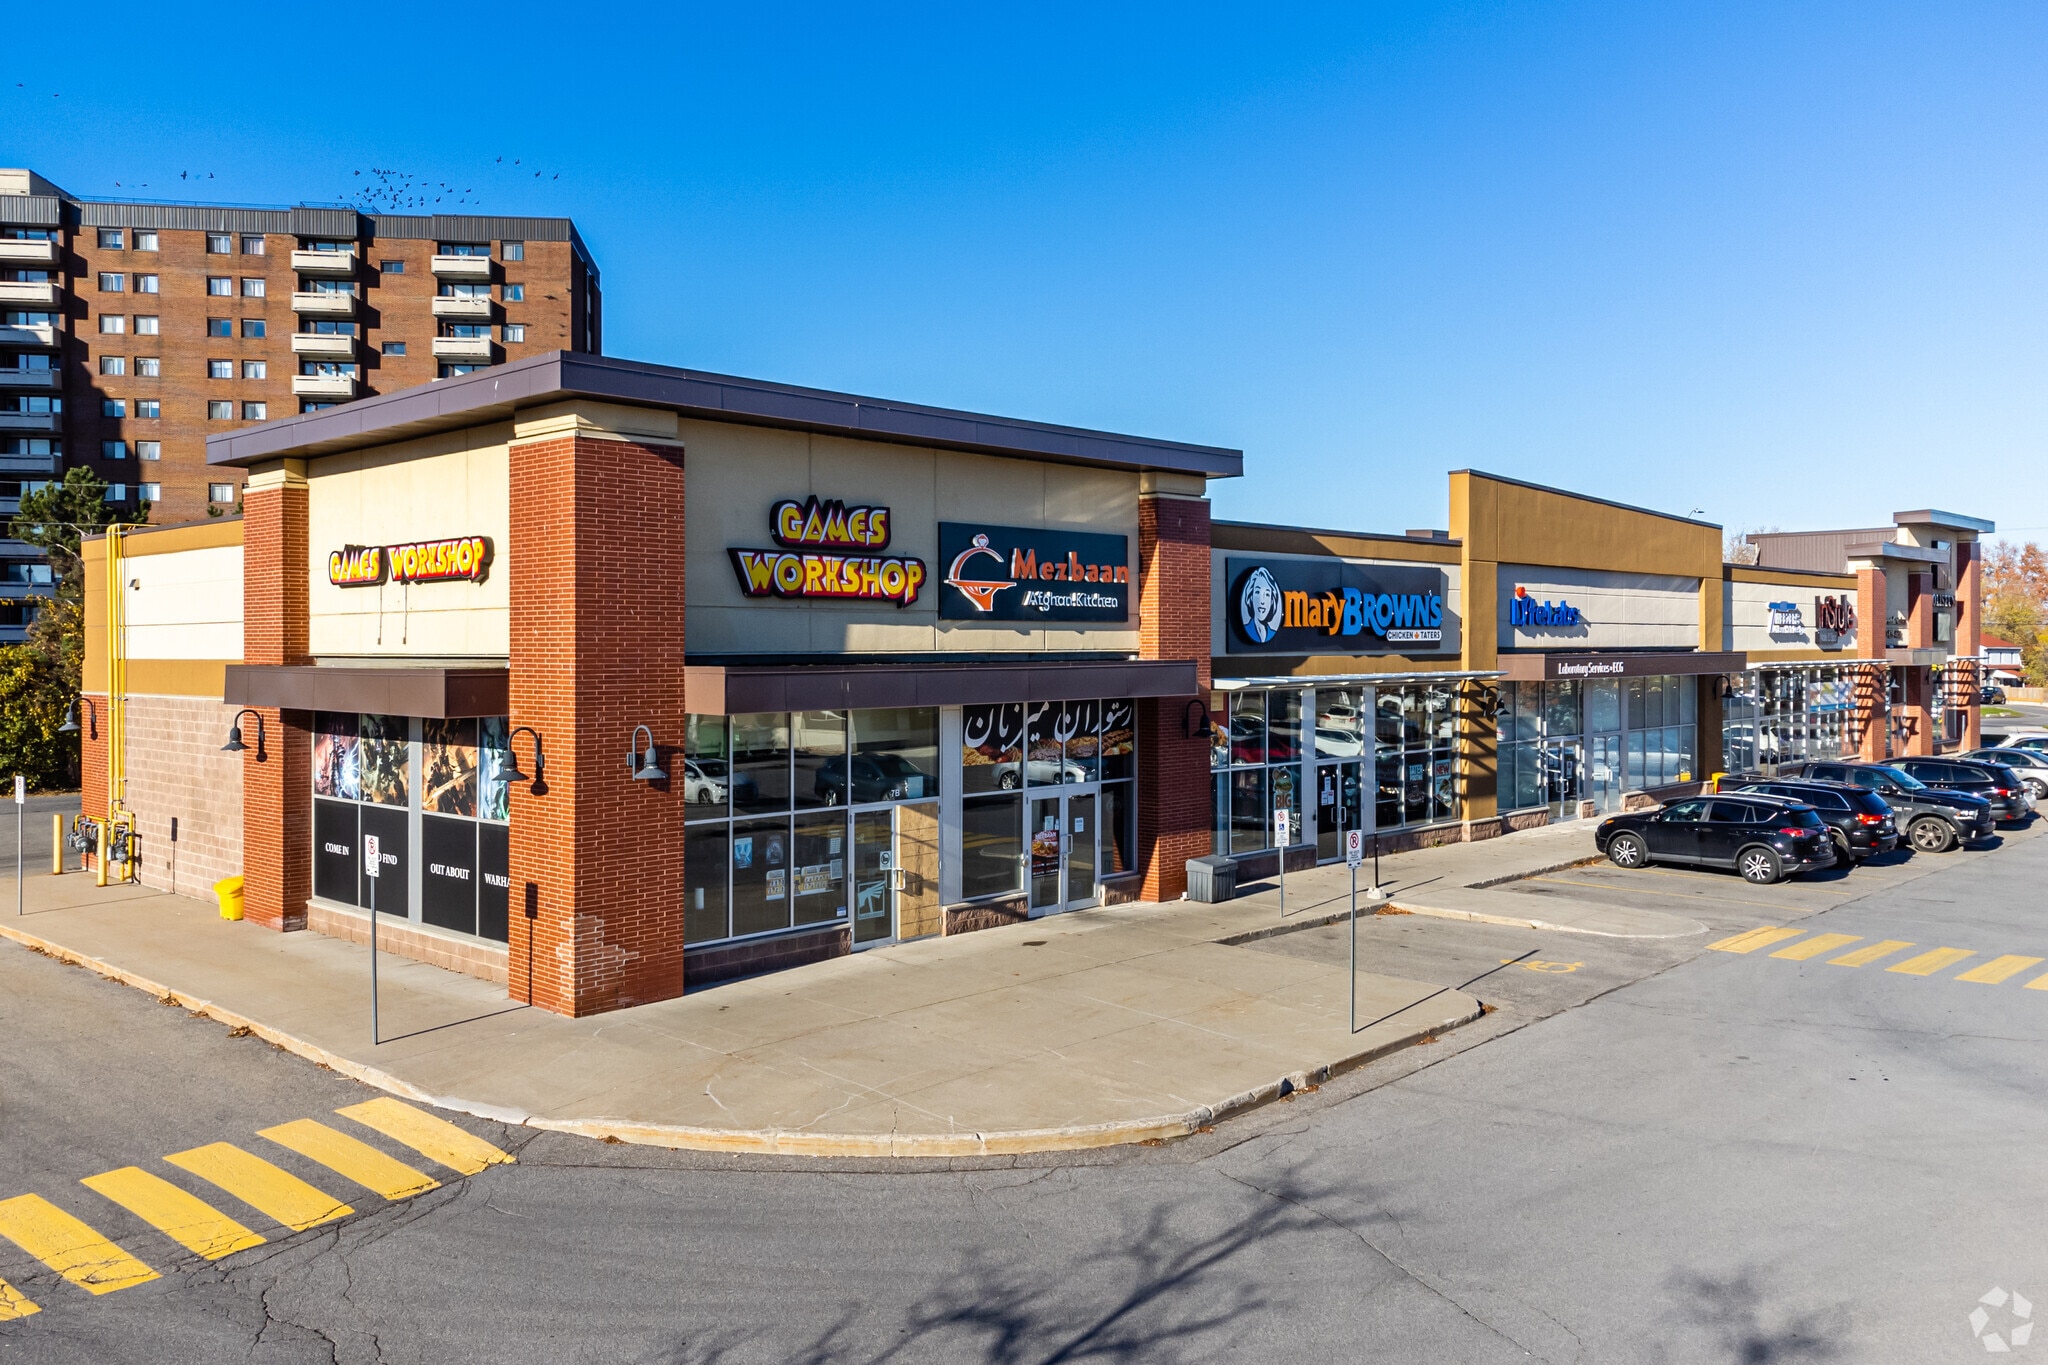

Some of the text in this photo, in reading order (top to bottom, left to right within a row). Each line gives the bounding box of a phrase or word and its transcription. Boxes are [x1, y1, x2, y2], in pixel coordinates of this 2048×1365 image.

[777, 502, 889, 547] GAMES
[330, 536, 485, 582] GAMES WORKSHOP
[1011, 548, 1129, 584] Mezbaan
[738, 551, 925, 604] WORKSHOP
[1025, 591, 1118, 611] Afghan Kitchen
[1387, 630, 1441, 640] CHICKEN TATERS
[1588, 662, 1609, 674] Services
[1612, 662, 1624, 673] ECG
[891, 789, 900, 797] 7B
[1276, 793, 1292, 809] BIG
[325, 842, 342, 855] COME
[342, 846, 349, 856] IN
[382, 853, 398, 865] FIND
[430, 863, 445, 876] OUT
[445, 866, 470, 880] ABOUT
